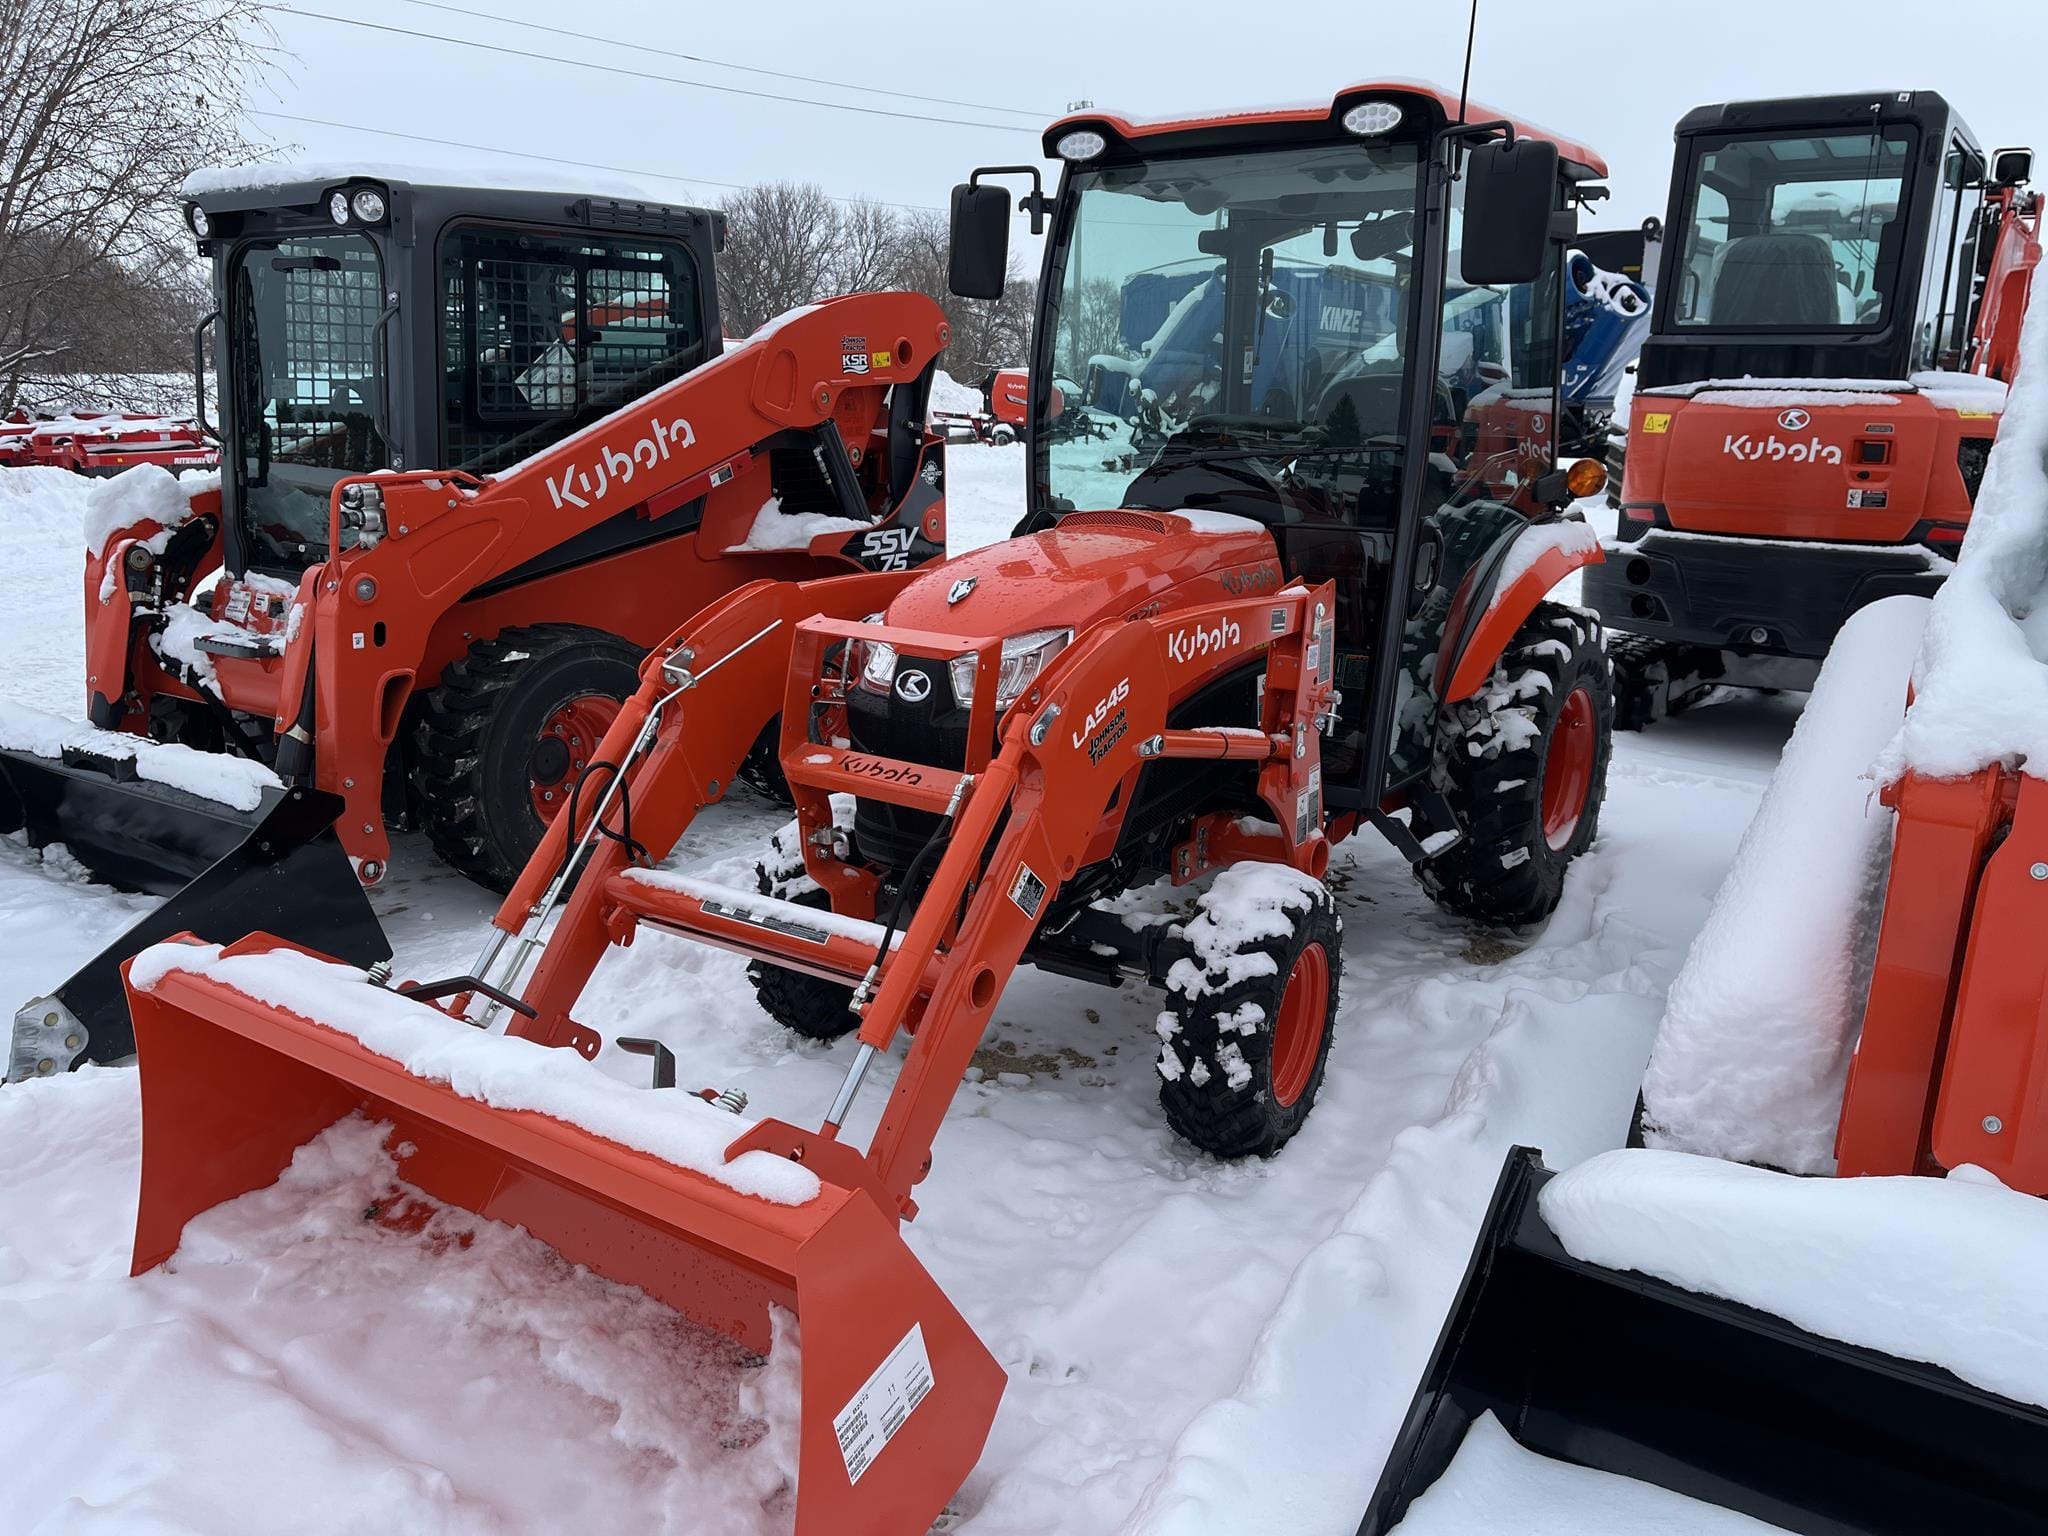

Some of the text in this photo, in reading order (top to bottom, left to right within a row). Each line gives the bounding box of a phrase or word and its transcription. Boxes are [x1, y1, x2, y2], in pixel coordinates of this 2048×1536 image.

[1320, 306, 1362, 333] KINZE
[842, 354, 868, 366] KSR
[545, 418, 697, 510] Kubota
[1723, 434, 1842, 464] Kubota
[861, 526, 920, 557] SSV
[880, 552, 908, 571] 75
[1219, 563, 1278, 597] Kubota
[1168, 617, 1240, 663] Kubota
[1072, 677, 1130, 749] LA545
[1088, 708, 1126, 756] JOHNSON
[1090, 722, 1128, 768] TRACTOR
[838, 755, 922, 786] Kubota
